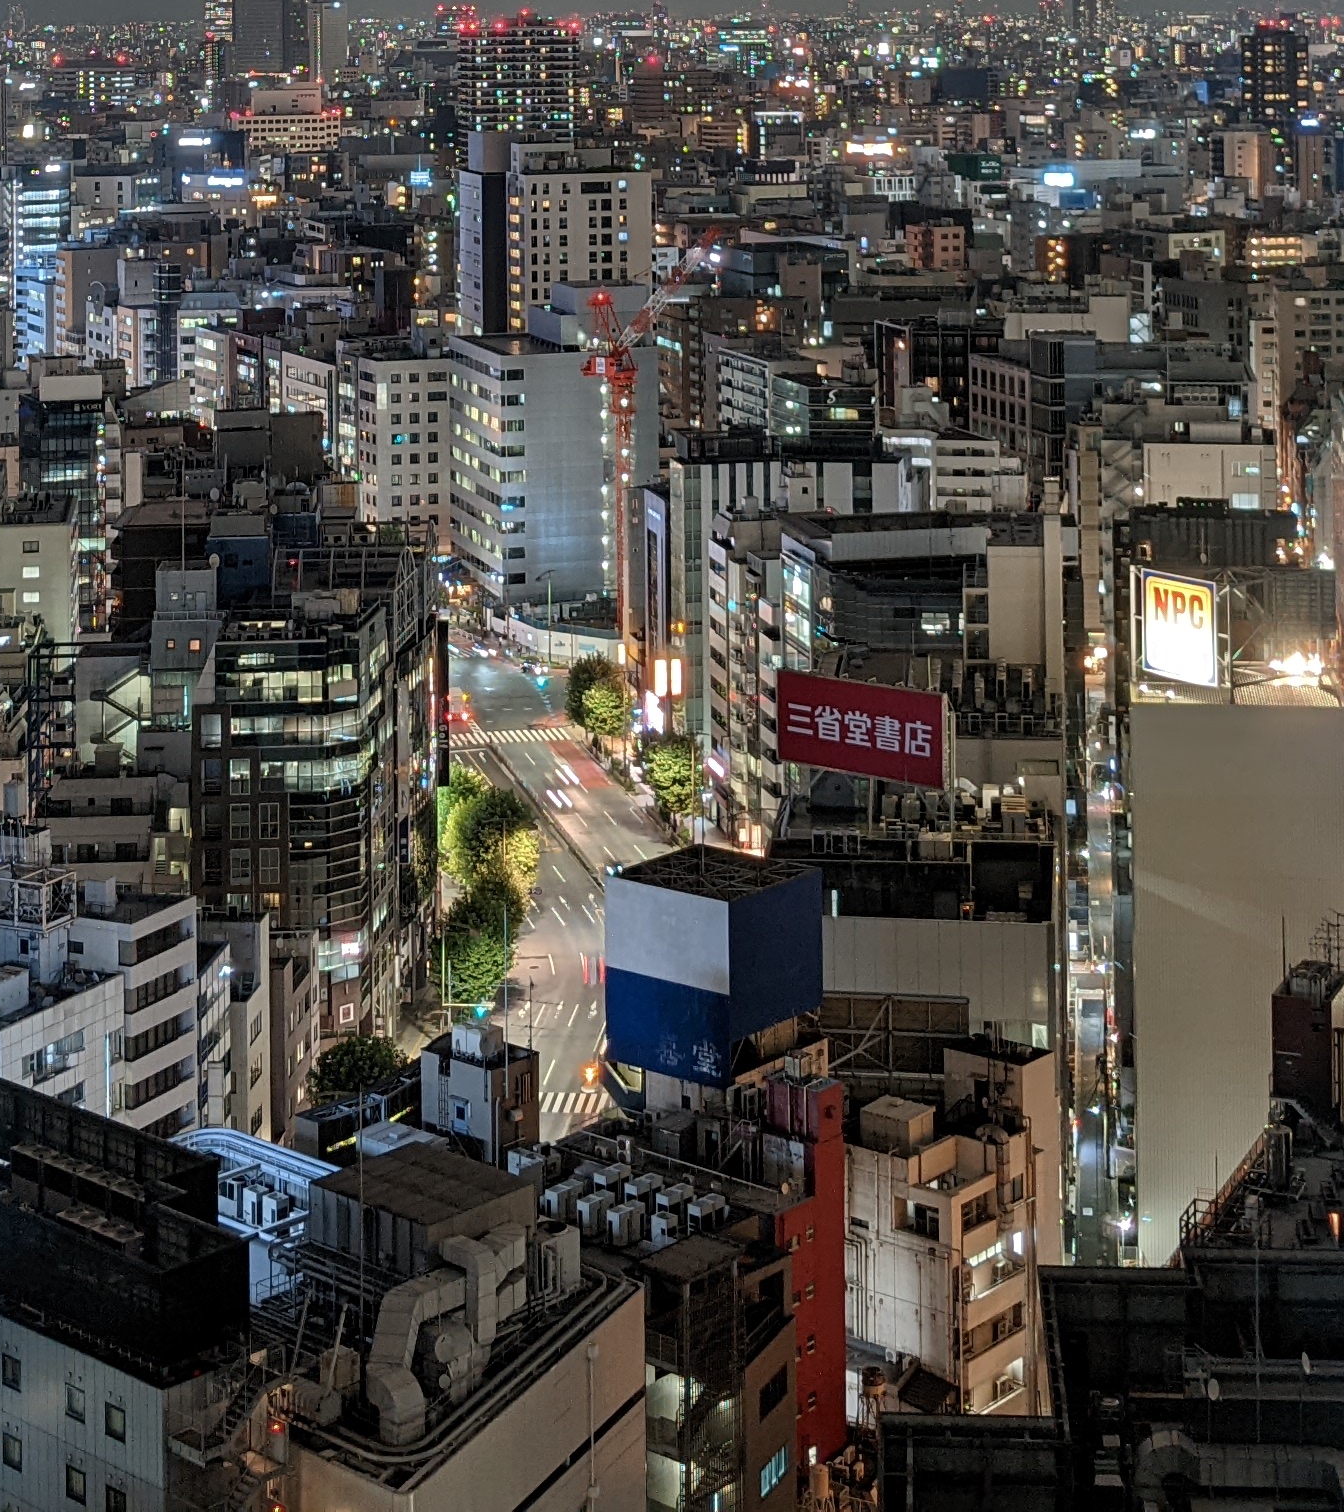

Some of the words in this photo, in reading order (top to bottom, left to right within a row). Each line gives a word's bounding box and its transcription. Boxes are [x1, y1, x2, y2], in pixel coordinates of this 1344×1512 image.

[1152, 586, 1204, 630] NPC
[438, 724, 449, 749] Golf
[786, 702, 933, 758] 三省堂書店
